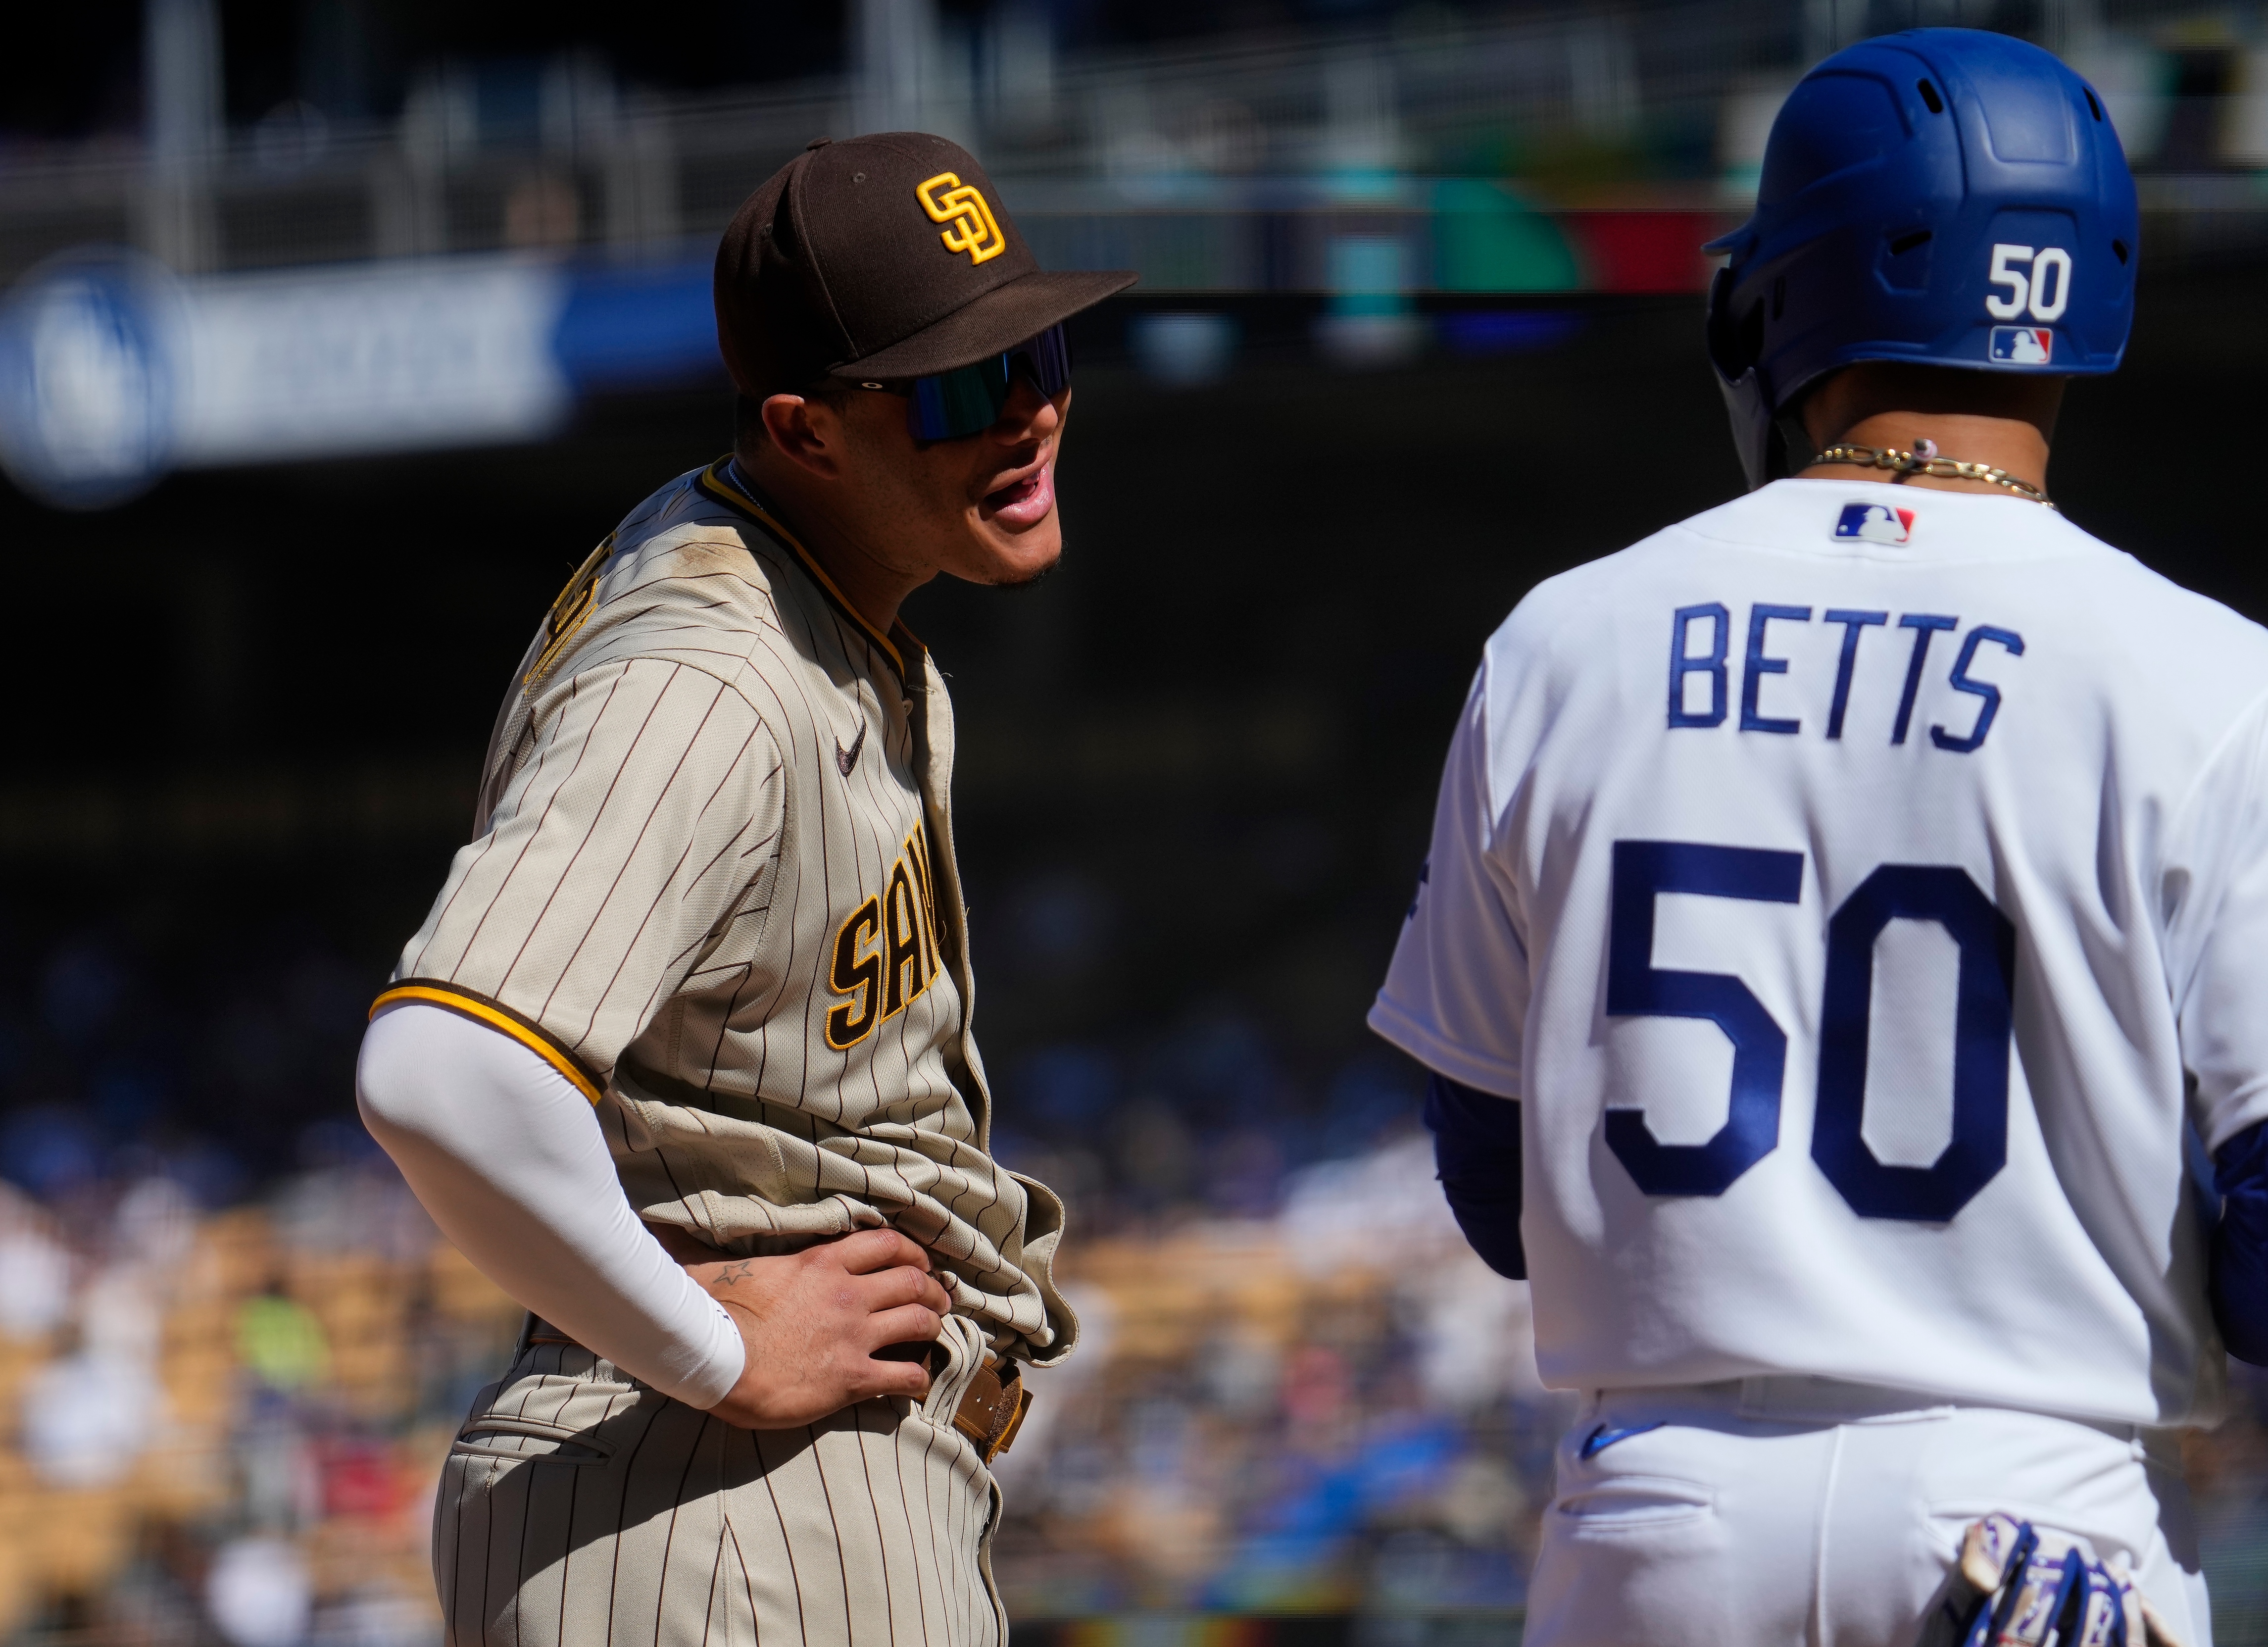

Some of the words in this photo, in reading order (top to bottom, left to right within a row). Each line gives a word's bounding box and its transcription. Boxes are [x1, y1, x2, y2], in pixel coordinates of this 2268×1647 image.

[1985, 243, 2072, 323] 50
[1668, 601, 2025, 753] BETTS
[826, 817, 941, 1049] SAN
[1605, 839, 2017, 1222] 50
